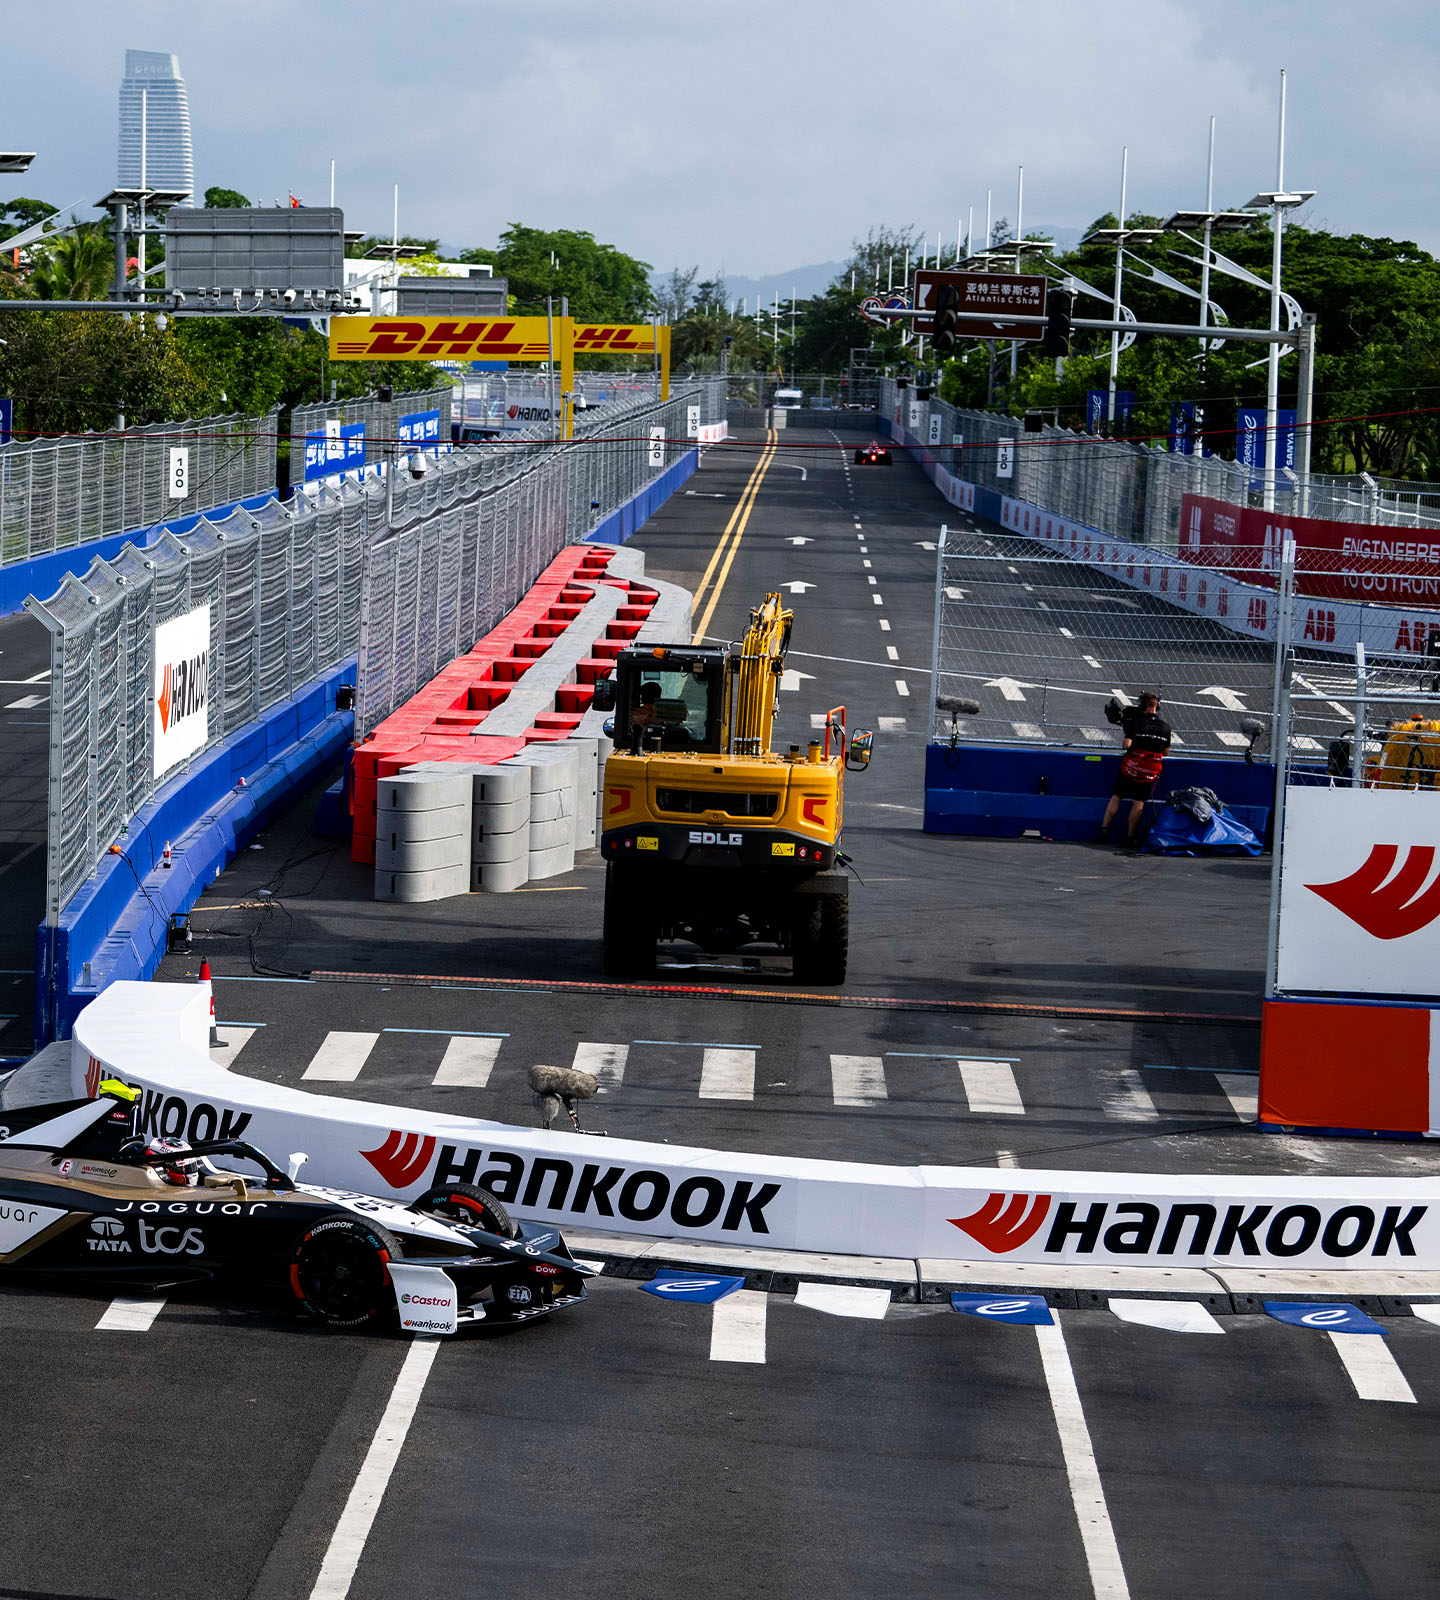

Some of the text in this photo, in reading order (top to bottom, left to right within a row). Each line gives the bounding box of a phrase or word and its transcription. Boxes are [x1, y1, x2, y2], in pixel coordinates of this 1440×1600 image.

[966, 282, 1040, 297] 亚特兰蒂斯C秀
[966, 294, 1005, 304] Atlantis
[1016, 296, 1040, 305] Show
[366, 322, 524, 354] DHL
[574, 328, 639, 349] HL
[1286, 432, 1295, 466] SANYA
[1304, 608, 1336, 642] ABB
[688, 831, 743, 846] SDLG
[62, 1161, 71, 1173] E
[87, 1239, 132, 1253] TATA
[535, 1265, 558, 1275] DOW
[411, 1295, 451, 1308] Castrol
